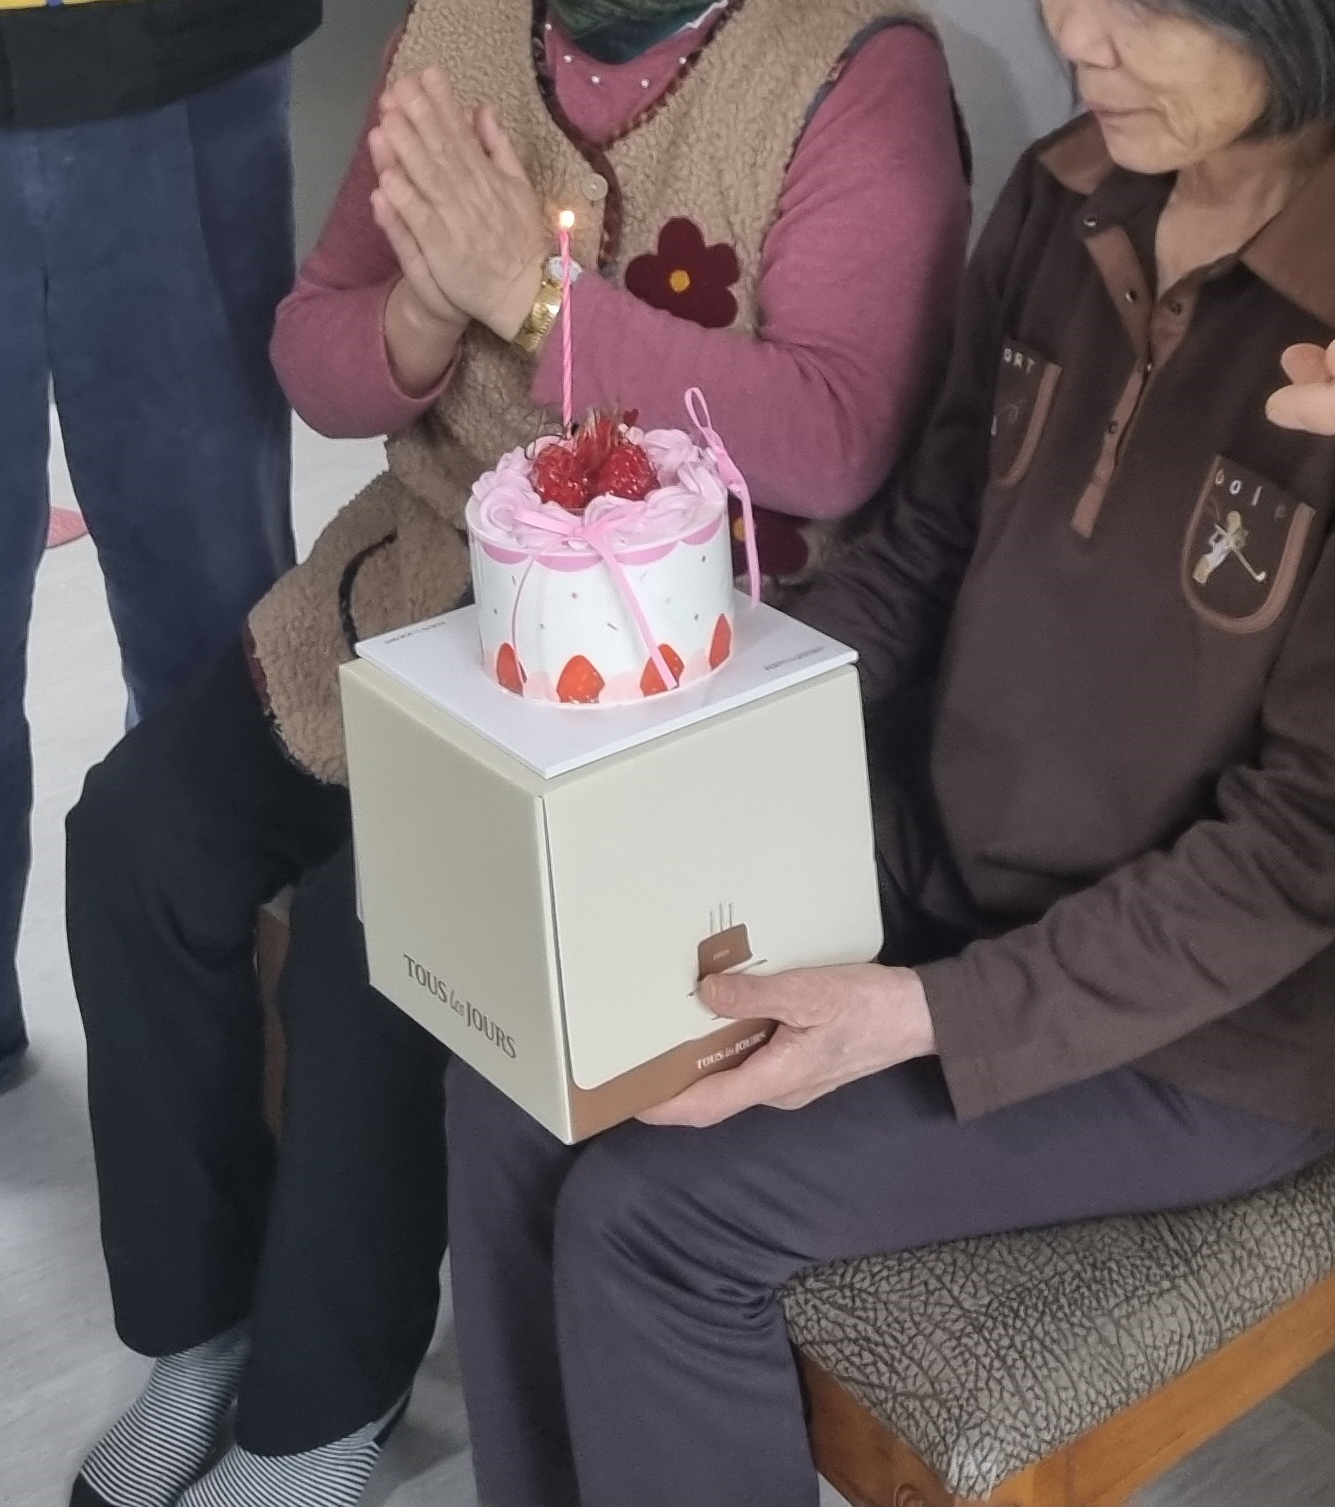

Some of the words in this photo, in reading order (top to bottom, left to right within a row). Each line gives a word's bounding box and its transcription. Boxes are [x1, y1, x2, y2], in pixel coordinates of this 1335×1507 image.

[403, 952, 447, 1003] TOUS
[466, 1000, 516, 1059] JOURS
[696, 1050, 725, 1070] TOUS
